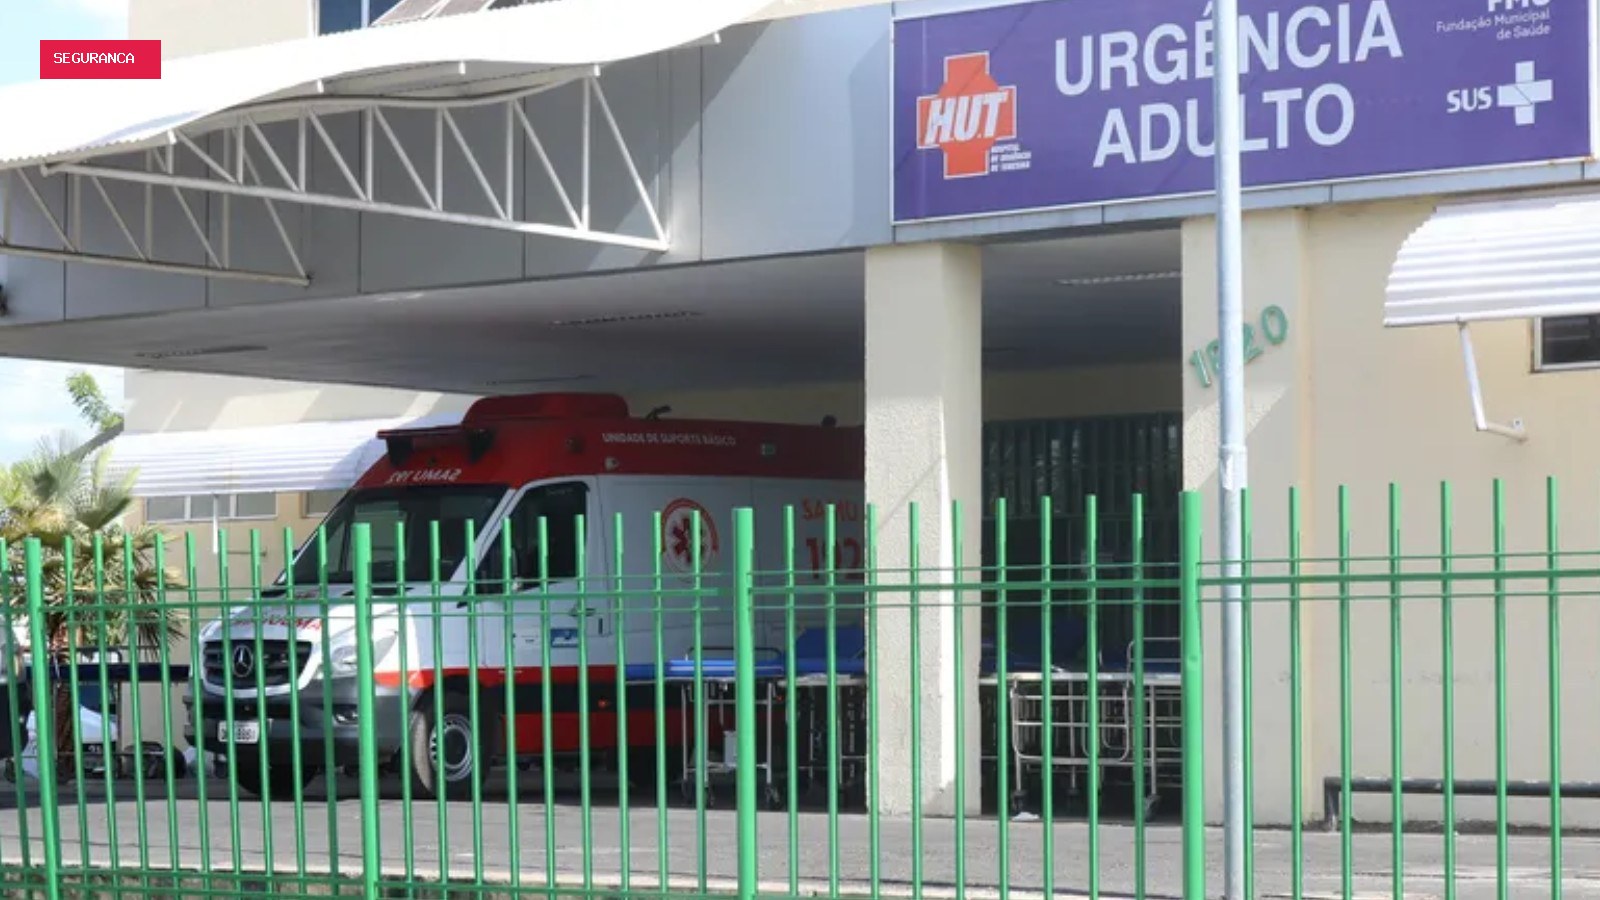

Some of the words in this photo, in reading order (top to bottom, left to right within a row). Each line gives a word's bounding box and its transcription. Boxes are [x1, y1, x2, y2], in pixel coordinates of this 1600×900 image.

[1436, 17, 1491, 32] Fundação
[1494, 9, 1550, 26] Municipal
[1496, 28, 1511, 40] de
[1513, 24, 1550, 38] Saúde
[1446, 86, 1492, 113] SUS
[1093, 83, 1355, 168] ADULTO
[602, 432, 645, 443] UNIDADE
[646, 433, 659, 444] DE
[660, 433, 702, 445] SUPORTE
